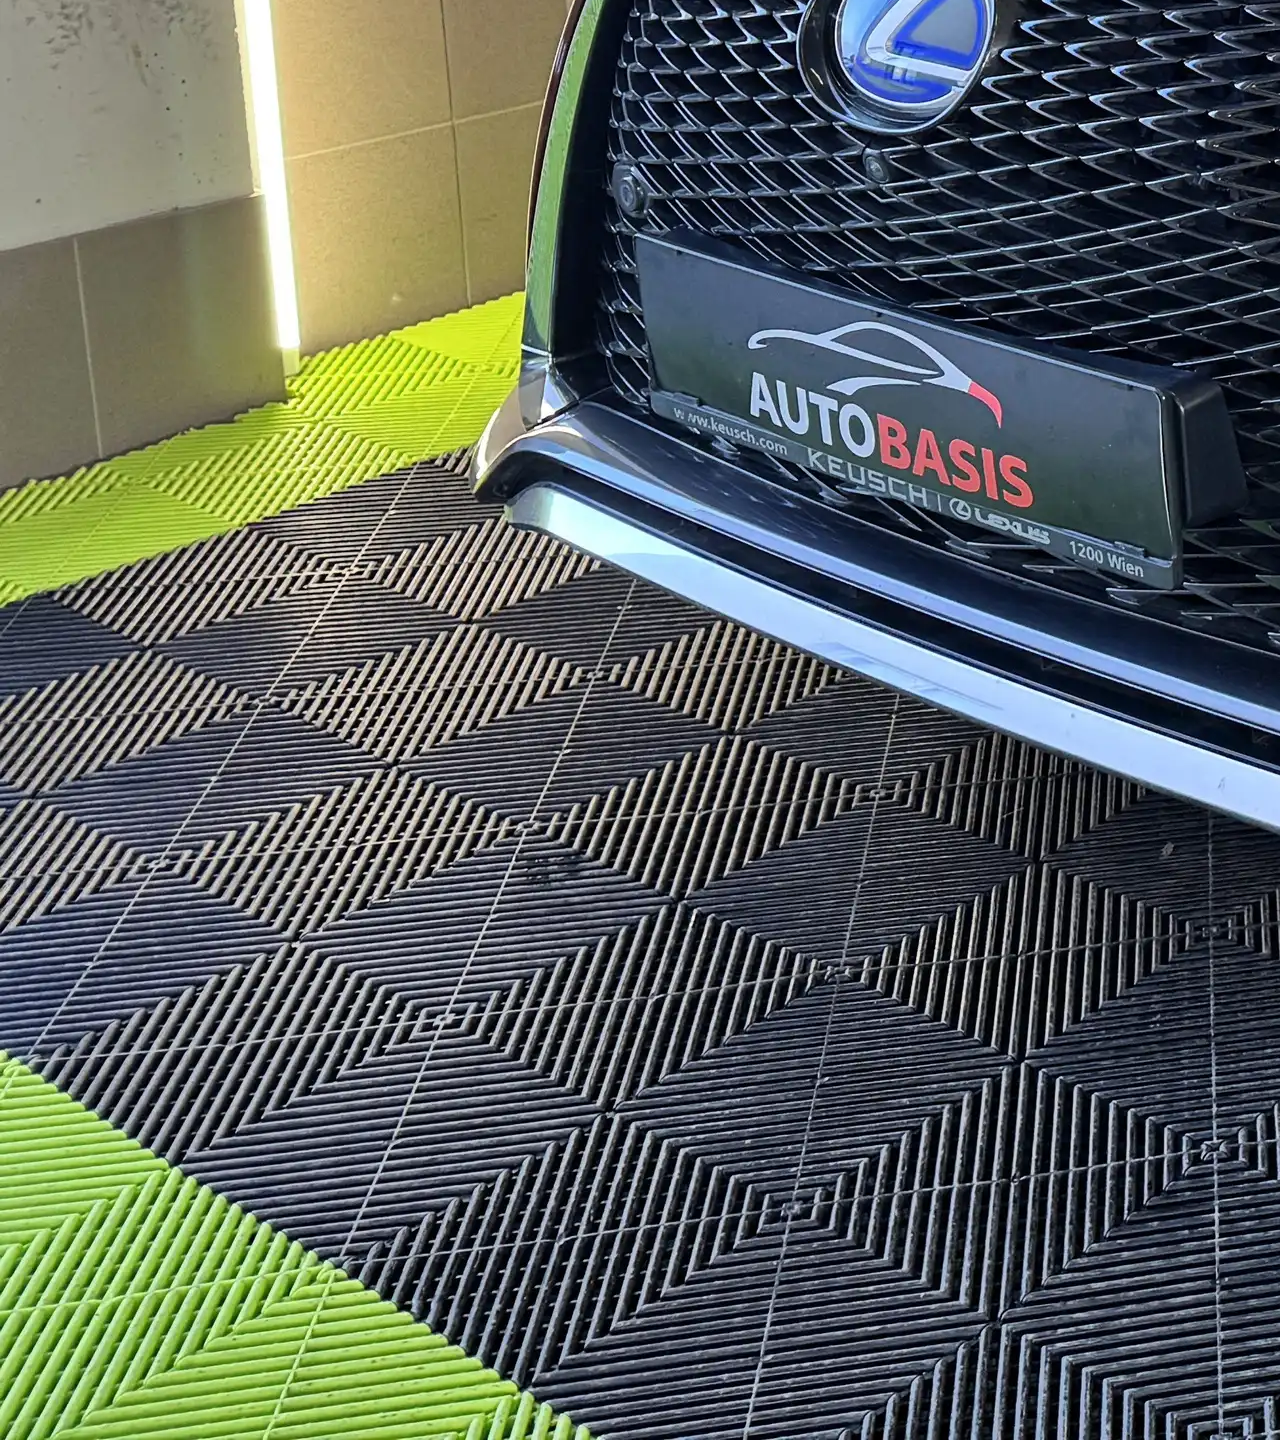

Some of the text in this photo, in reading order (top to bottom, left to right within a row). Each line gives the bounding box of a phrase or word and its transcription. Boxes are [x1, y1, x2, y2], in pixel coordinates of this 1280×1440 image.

[673, 407, 788, 456] www.keusch.com
[750, 371, 1034, 508] AUTOBASIS
[807, 447, 928, 508] KEUSCH
[974, 507, 1050, 545] LEXUS
[1069, 540, 1144, 577] 1200 Wien
